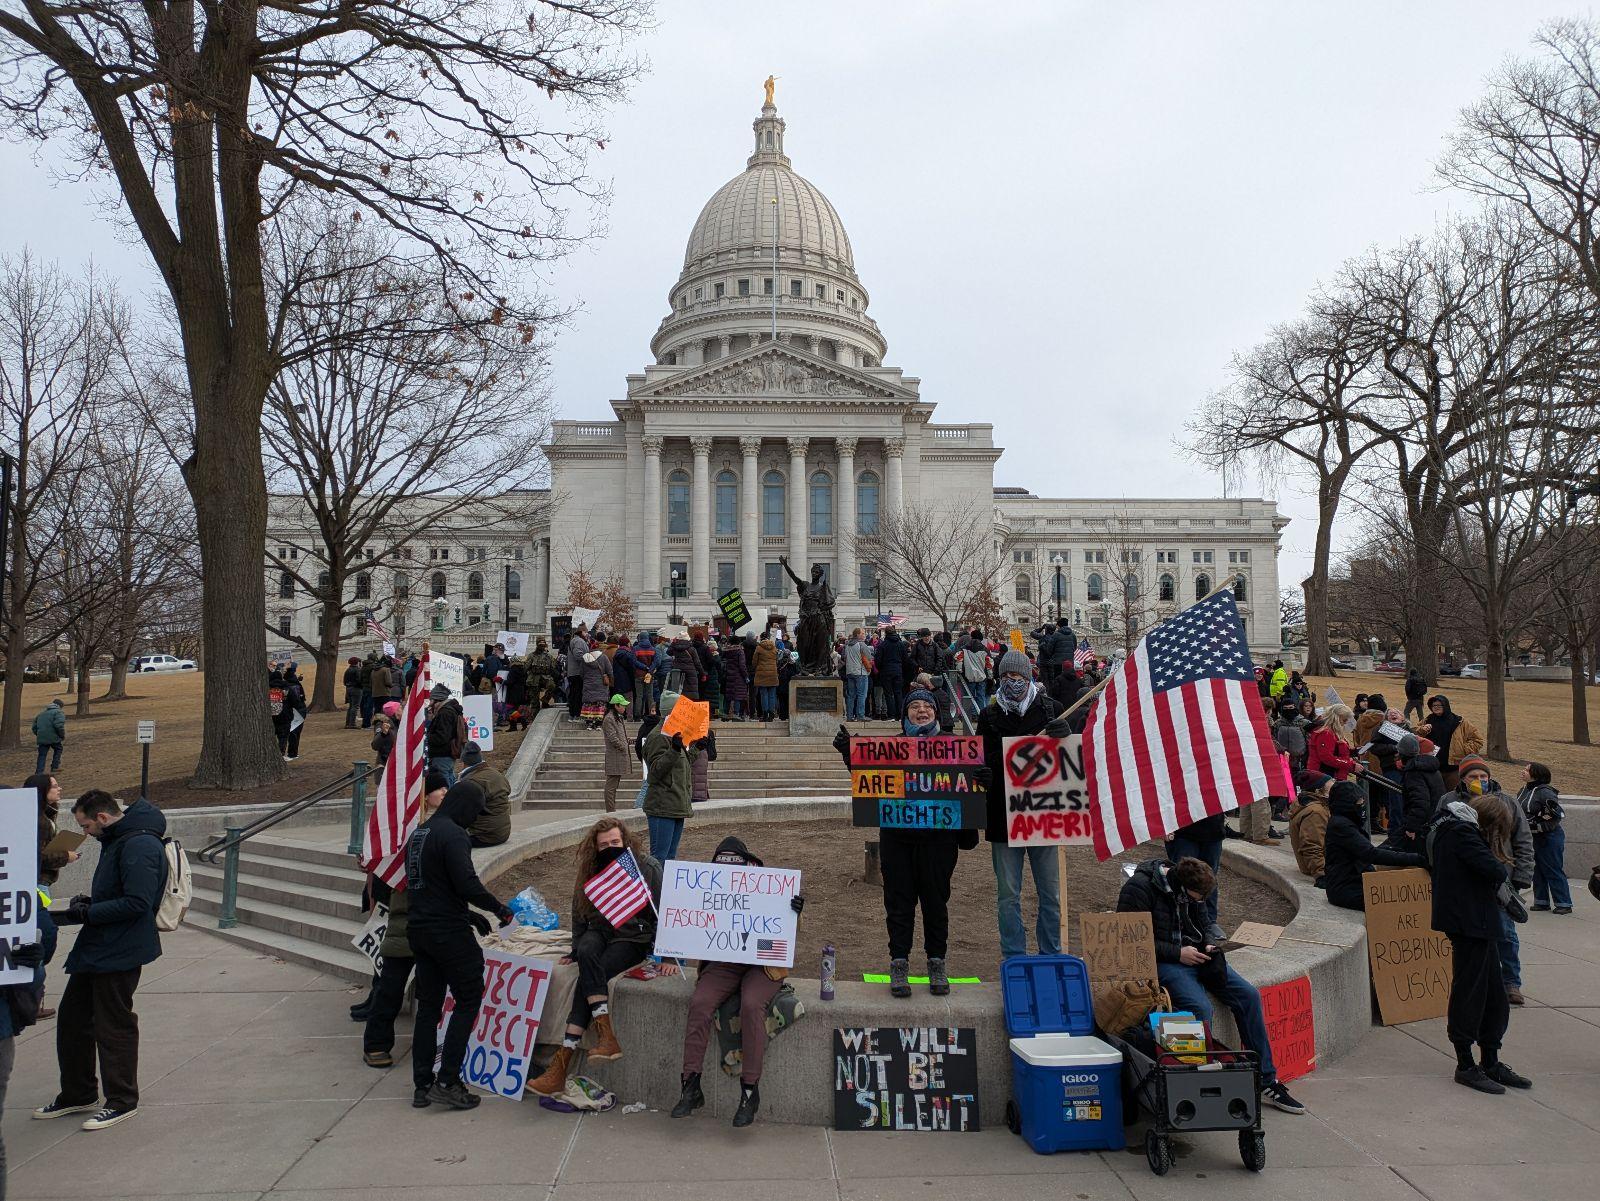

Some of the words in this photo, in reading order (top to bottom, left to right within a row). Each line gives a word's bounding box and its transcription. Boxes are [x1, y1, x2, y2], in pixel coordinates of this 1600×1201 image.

[439, 659, 463, 674] MARCH
[856, 741, 910, 760] TRANS
[1058, 744, 1085, 781] N
[858, 774, 896, 794] ARE
[1011, 812, 1091, 840] AMERI
[674, 868, 723, 891] FUCK
[730, 871, 797, 897] FASCISM
[702, 892, 751, 911] BEFORE
[664, 907, 717, 929] FASCISM
[731, 913, 782, 934] FUCKS
[1084, 919, 1149, 945] DEMAND
[1397, 914, 1420, 930] ARE
[358, 932, 384, 970] RIG
[705, 930, 750, 951] YOU!
[1375, 936, 1452, 970] ROBBING
[1087, 945, 1153, 974] YOUR
[482, 958, 549, 1012] JECT
[1393, 966, 1450, 1001] US(A)
[1262, 992, 1274, 1017] TE
[839, 1028, 880, 1054] WE
[898, 1028, 967, 1055] WILL
[836, 1054, 893, 1091] NOT
[908, 1052, 946, 1089] BE
[1061, 1074, 1099, 1084] IGLOO
[855, 1090, 975, 1132] SILENT
